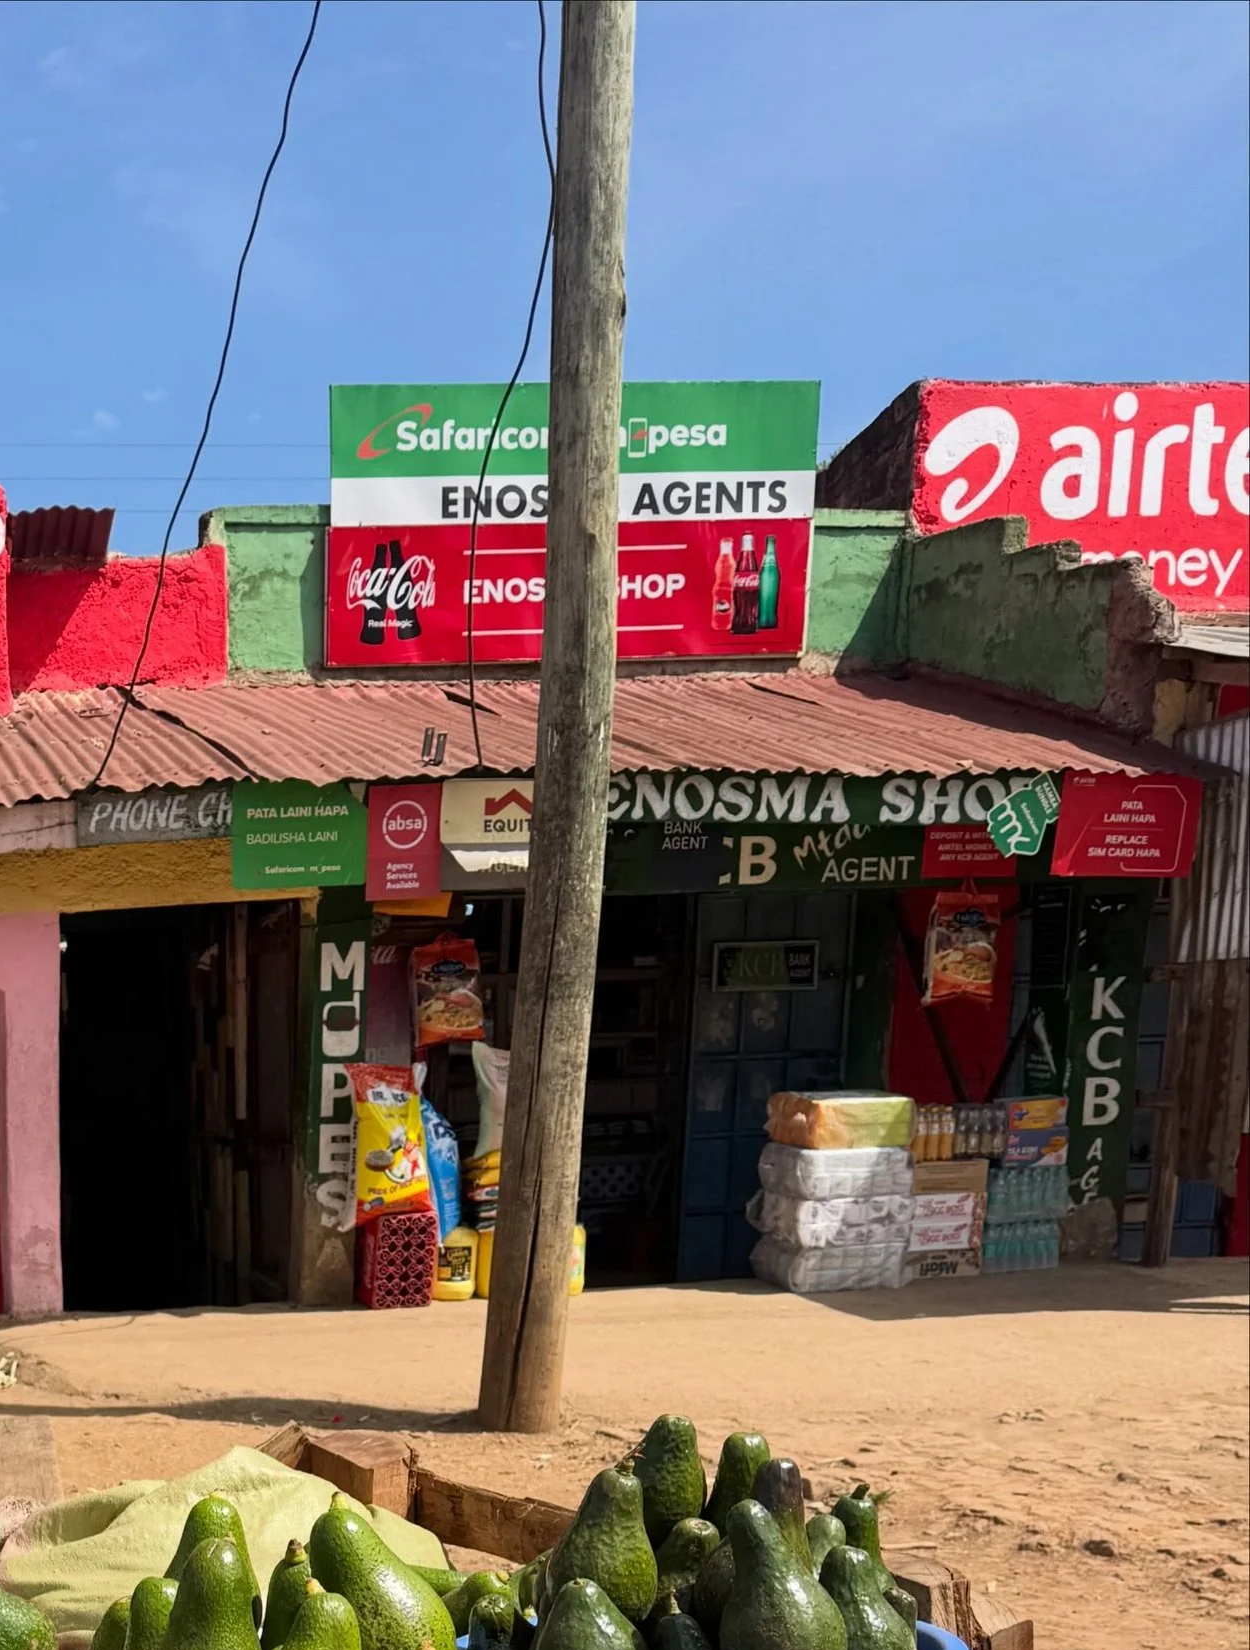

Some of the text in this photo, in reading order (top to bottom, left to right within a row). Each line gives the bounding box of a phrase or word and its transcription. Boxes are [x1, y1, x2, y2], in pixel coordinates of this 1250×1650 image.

[397, 416, 548, 452] Safarico
[442, 480, 787, 519] ENOS AGENTS
[346, 555, 436, 610] Coca-Cola
[463, 573, 686, 604] ENOS HOP
[368, 619, 413, 629] Real Magic
[606, 773, 850, 823] ENOSMA
[1121, 800, 1143, 810] PATA
[90, 791, 233, 833] PHONE CH
[247, 805, 349, 819] PATA LAINI HAPA
[1103, 813, 1156, 823] LAINI HAPA
[387, 814, 423, 831] absa
[484, 818, 533, 833] EQUIT
[663, 821, 703, 835] BANK
[246, 830, 339, 846] BADILISHA LAINI
[662, 836, 708, 850] AGENT
[1105, 835, 1149, 845] REPLACE
[1087, 847, 1161, 858] SIM CARD HAPA
[386, 862, 414, 874] Agency
[821, 856, 916, 884] AGENT
[386, 872, 417, 881] Services
[386, 881, 420, 890] Available
[1082, 975, 1127, 1126] KCB
